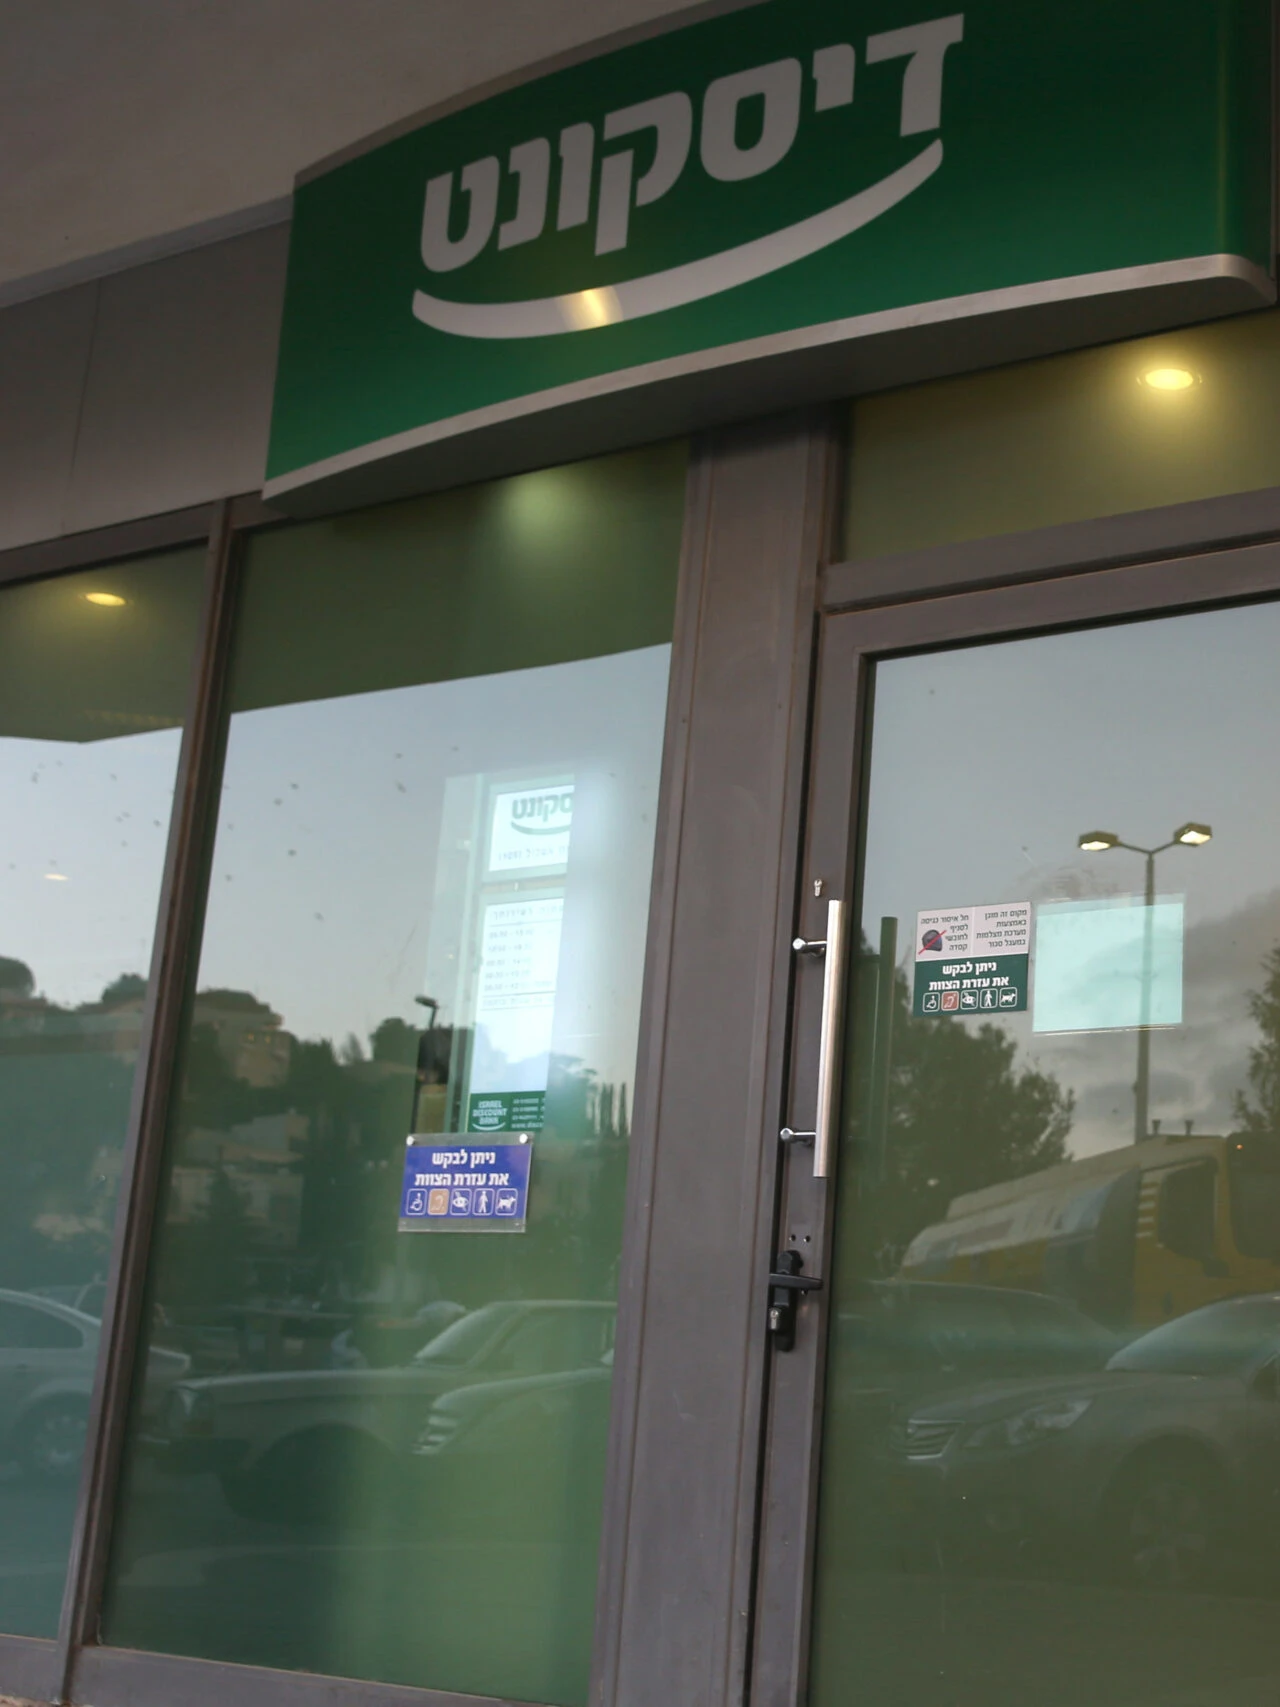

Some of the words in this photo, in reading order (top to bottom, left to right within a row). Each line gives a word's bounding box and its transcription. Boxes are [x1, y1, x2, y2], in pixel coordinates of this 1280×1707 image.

[420, 12, 964, 273] דיסקונט
[1010, 909, 1027, 917] מקום
[950, 924, 968, 932] לסניף
[996, 920, 1026, 928] באמצעות
[976, 930, 1002, 939] מצלמות
[949, 944, 967, 952] קסדה
[942, 962, 973, 977] לבקש
[976, 962, 997, 975] ניתן
[929, 979, 960, 991] הצוות
[962, 978, 990, 988] עזרת
[992, 976, 1009, 986] את
[432, 1149, 467, 1168] לבקש
[470, 1152, 496, 1168] ניתן
[414, 1173, 451, 1186] הצוות
[454, 1173, 486, 1186] עזרת
[489, 1173, 509, 1185] את
